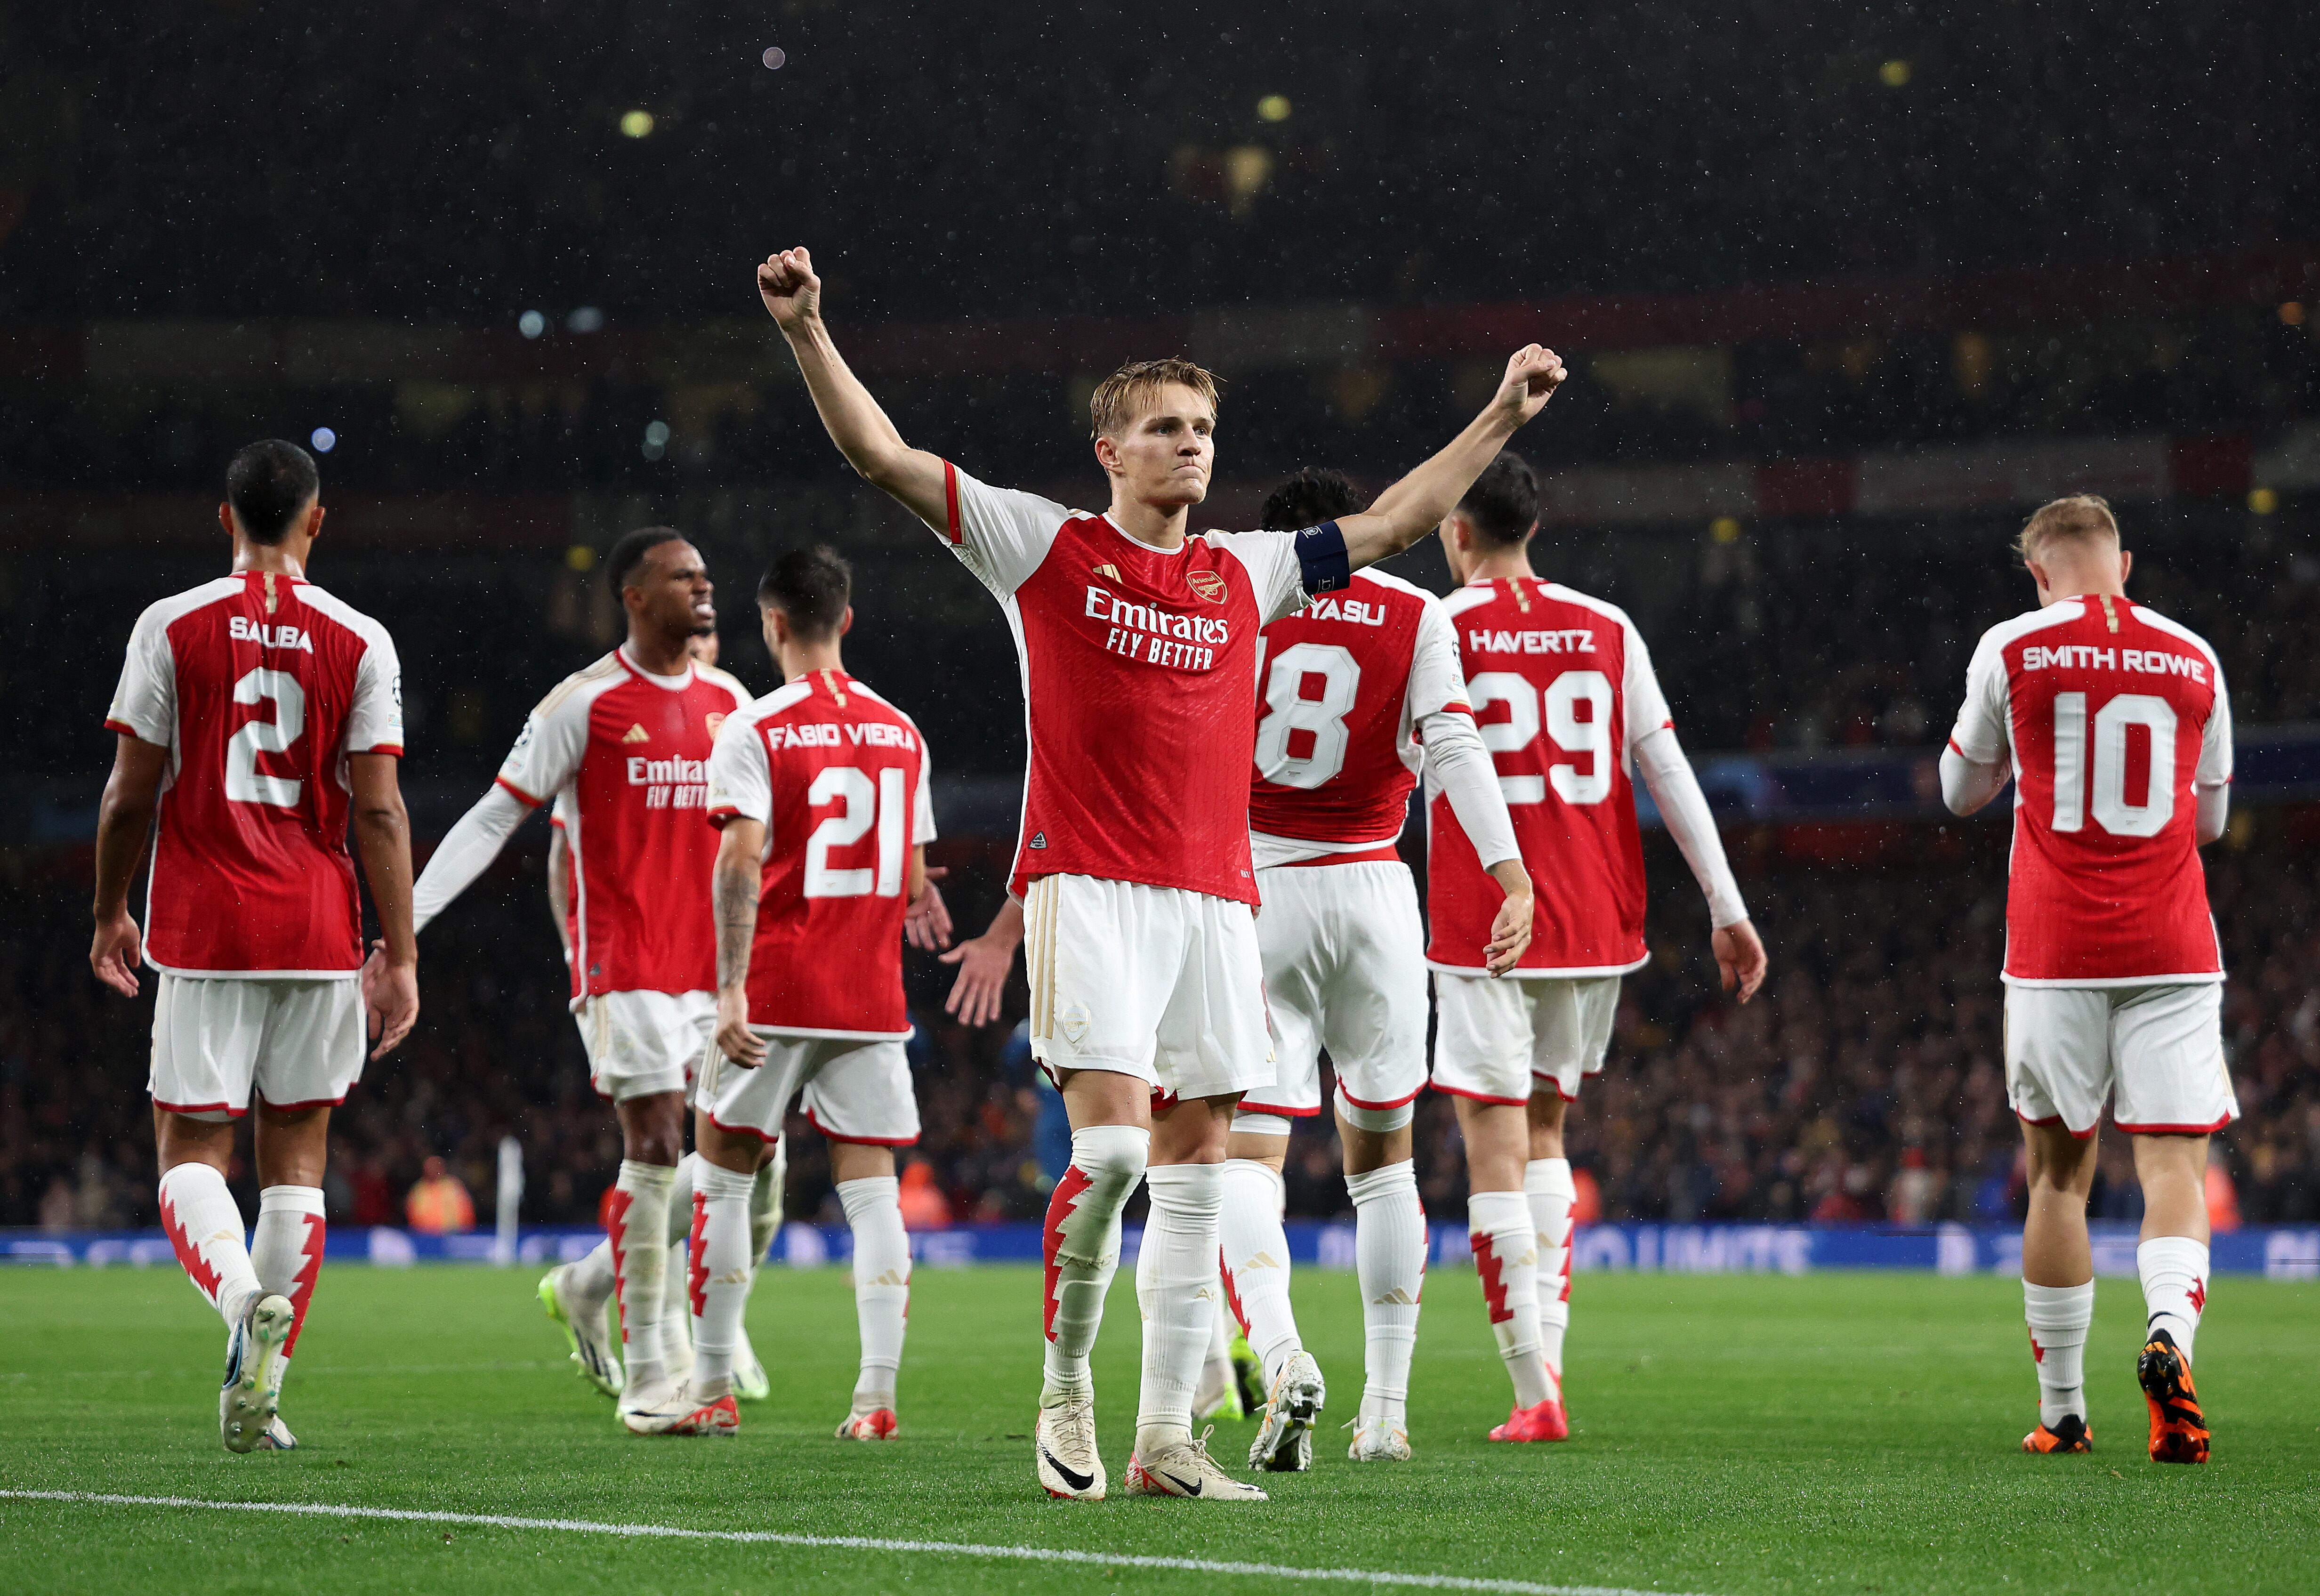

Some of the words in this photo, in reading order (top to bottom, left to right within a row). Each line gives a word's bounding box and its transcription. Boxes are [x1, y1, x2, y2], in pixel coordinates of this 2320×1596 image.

[1192, 575, 1216, 584] Arsenal
[1085, 585, 1229, 644] Emirates
[1290, 598, 1386, 626] YASU
[1106, 628, 1144, 658] FLY
[1469, 629, 1595, 654] HAVERTZ
[2022, 645, 2116, 671] SMITH
[2122, 648, 2207, 685] ROWE
[226, 666, 306, 808] 2
[767, 723, 842, 751] FÁBIO
[844, 722, 918, 753] VIEIRA
[1467, 670, 1613, 805] 29
[2052, 692, 2177, 837] 10
[646, 785, 673, 809] FLY
[673, 784, 708, 809] BETT
[803, 766, 906, 898] 21
